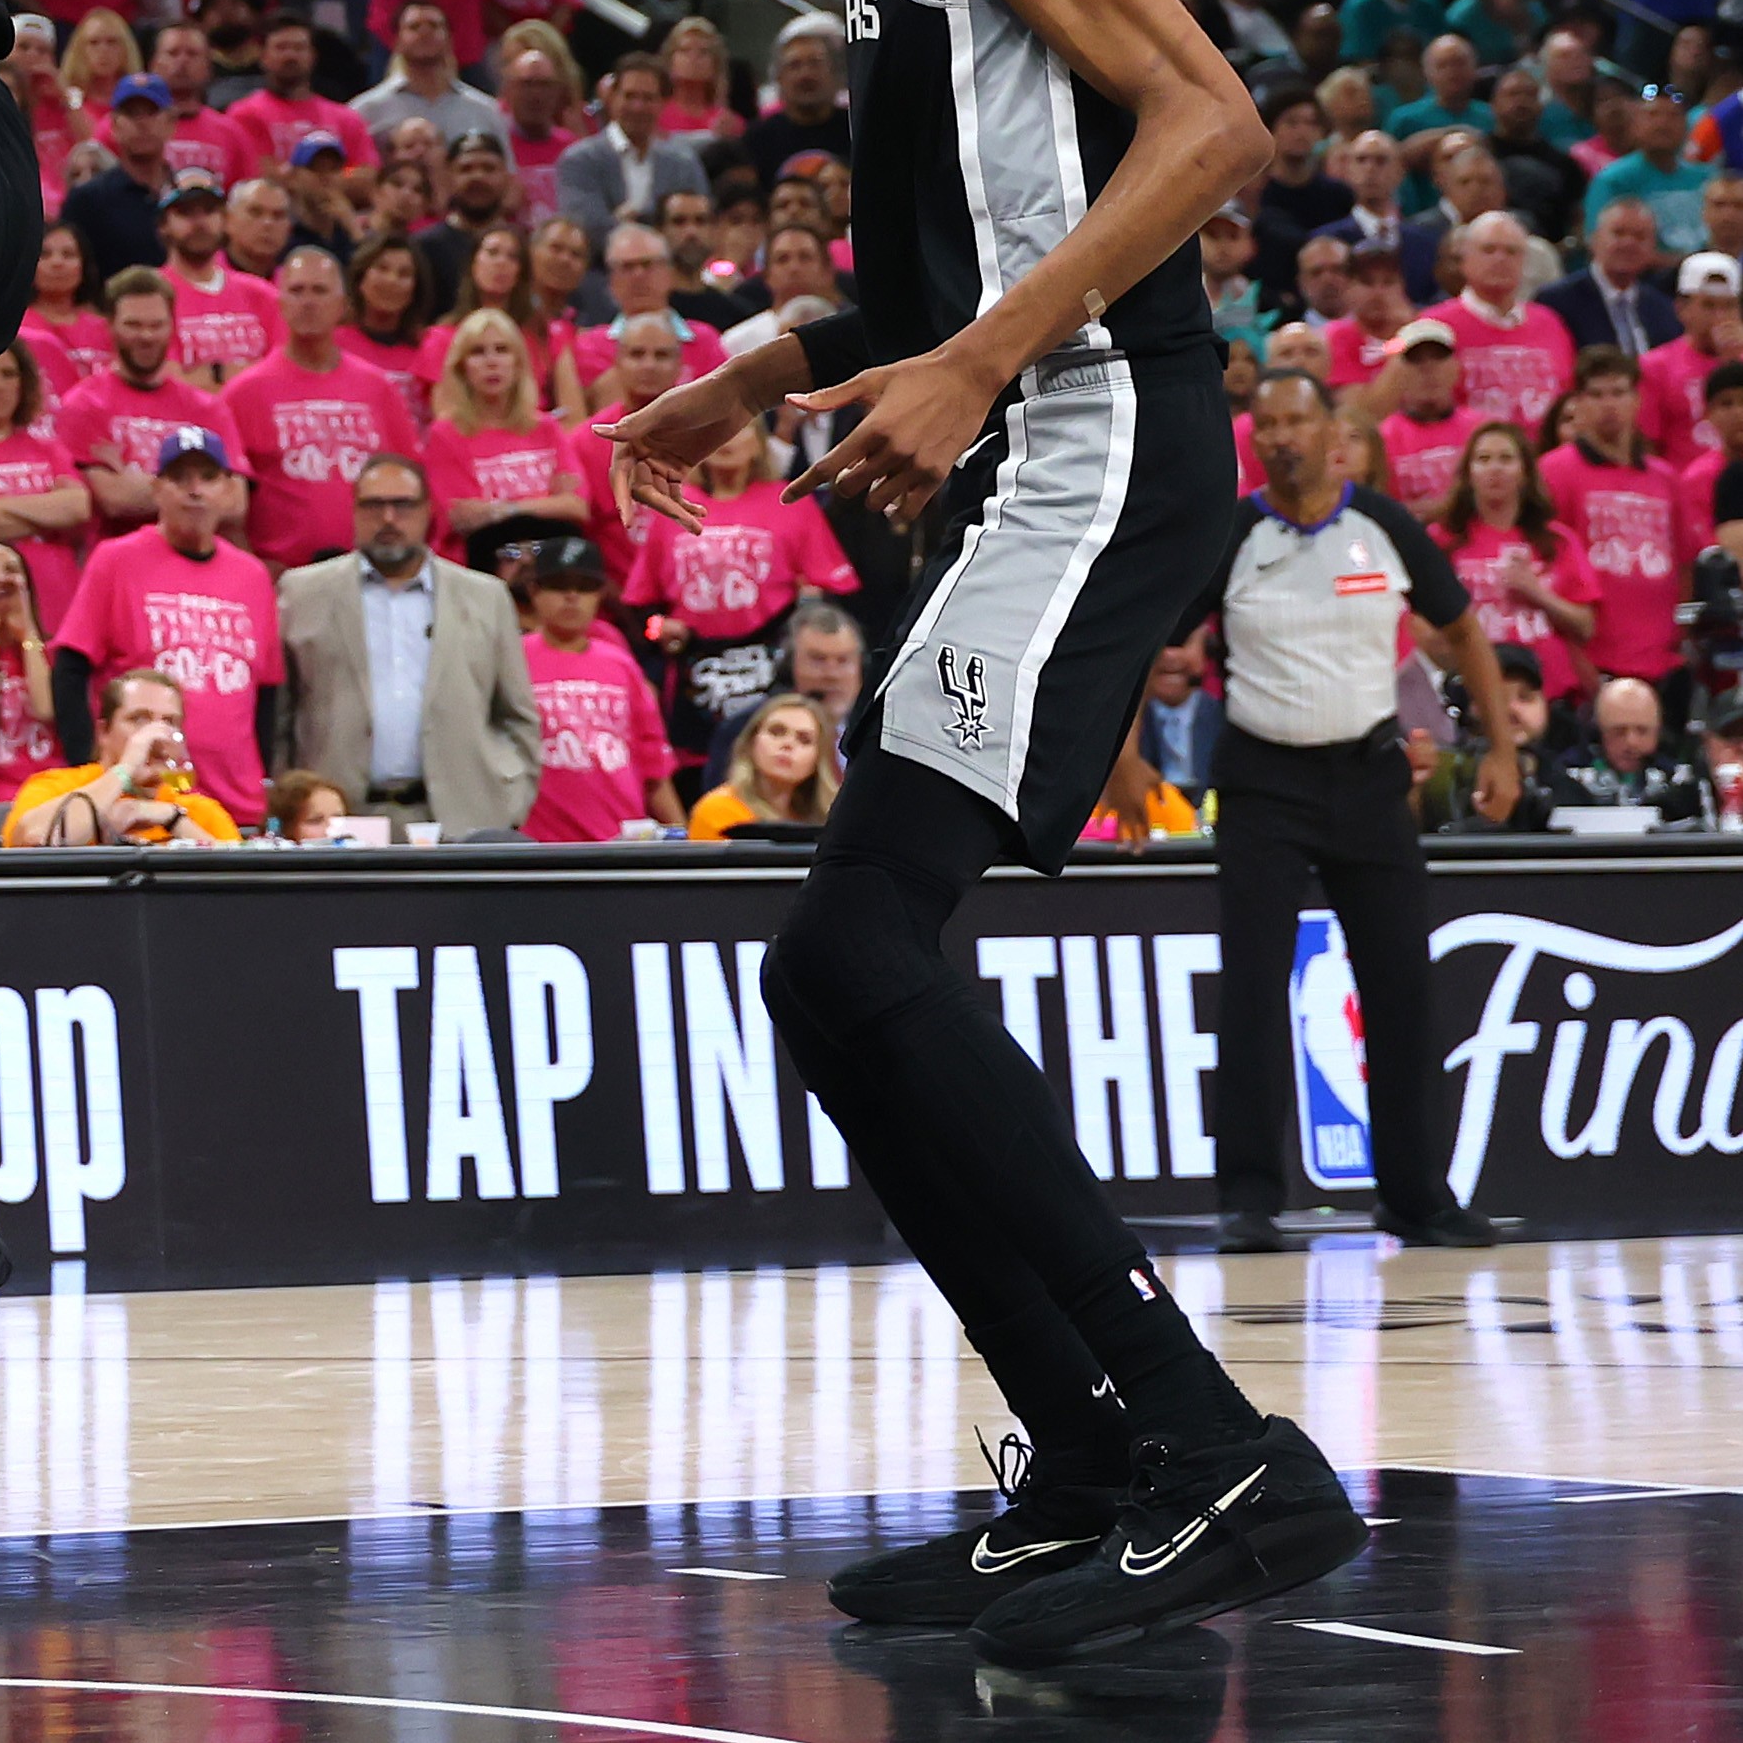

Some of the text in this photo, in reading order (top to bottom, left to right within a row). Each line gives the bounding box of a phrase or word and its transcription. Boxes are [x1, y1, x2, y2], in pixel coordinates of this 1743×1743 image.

[332, 943, 595, 1204] TAP
[976, 933, 1224, 1181] THE
[1317, 1124, 1367, 1169] NBA
